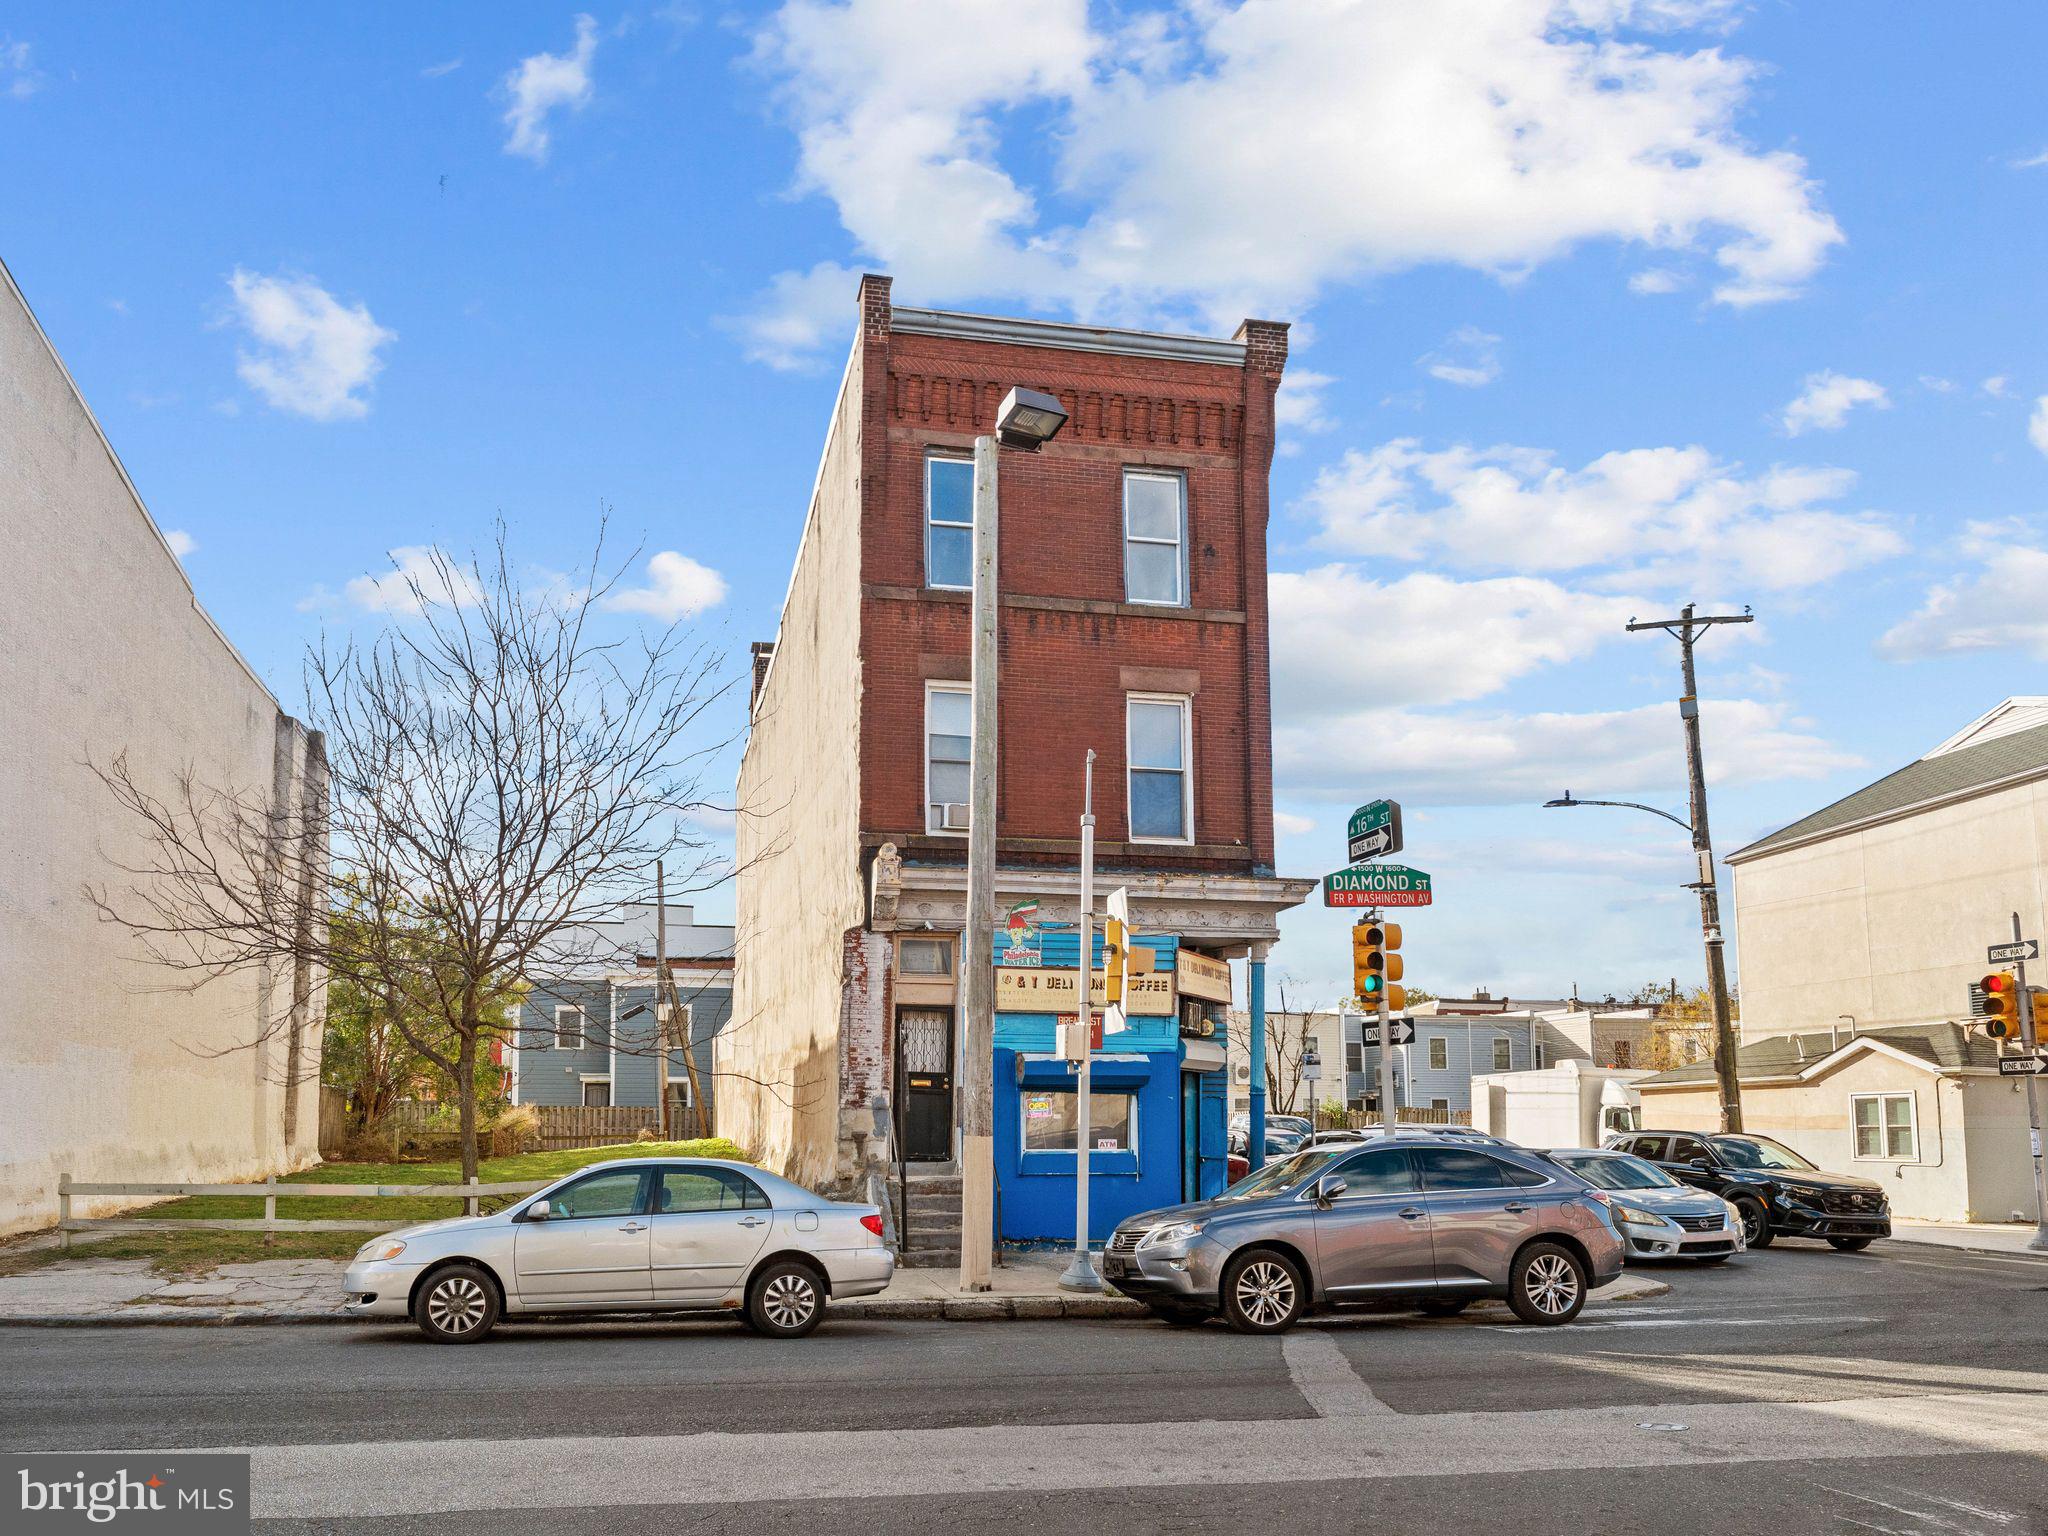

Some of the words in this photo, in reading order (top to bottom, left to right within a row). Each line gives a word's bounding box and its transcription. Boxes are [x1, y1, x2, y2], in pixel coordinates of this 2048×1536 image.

[1380, 812, 1390, 824] ST
[1353, 842, 1366, 854] ONE
[1366, 837, 1379, 850] WAY
[1376, 865, 1383, 873] W
[1333, 875, 1409, 890] DIAMOND
[1415, 880, 1428, 889] ST
[1334, 894, 1345, 903] FR
[1356, 893, 1415, 903] WASHINGTON
[1418, 894, 1429, 903] AV
[1004, 951, 1040, 959] Philadelphia
[1992, 950, 2007, 959] ONE
[2009, 947, 2025, 957] WAY
[1004, 957, 1028, 965] WATER
[1029, 956, 1040, 965] ICE
[1215, 968, 1230, 982] COFFEE
[1017, 975, 1026, 989] &
[1031, 976, 1038, 989] Y
[1047, 976, 1073, 989] DELI
[2003, 1062, 2018, 1070] ONE
[2020, 1060, 2034, 1069] WAY
[1029, 1102, 1049, 1110] OPEN
